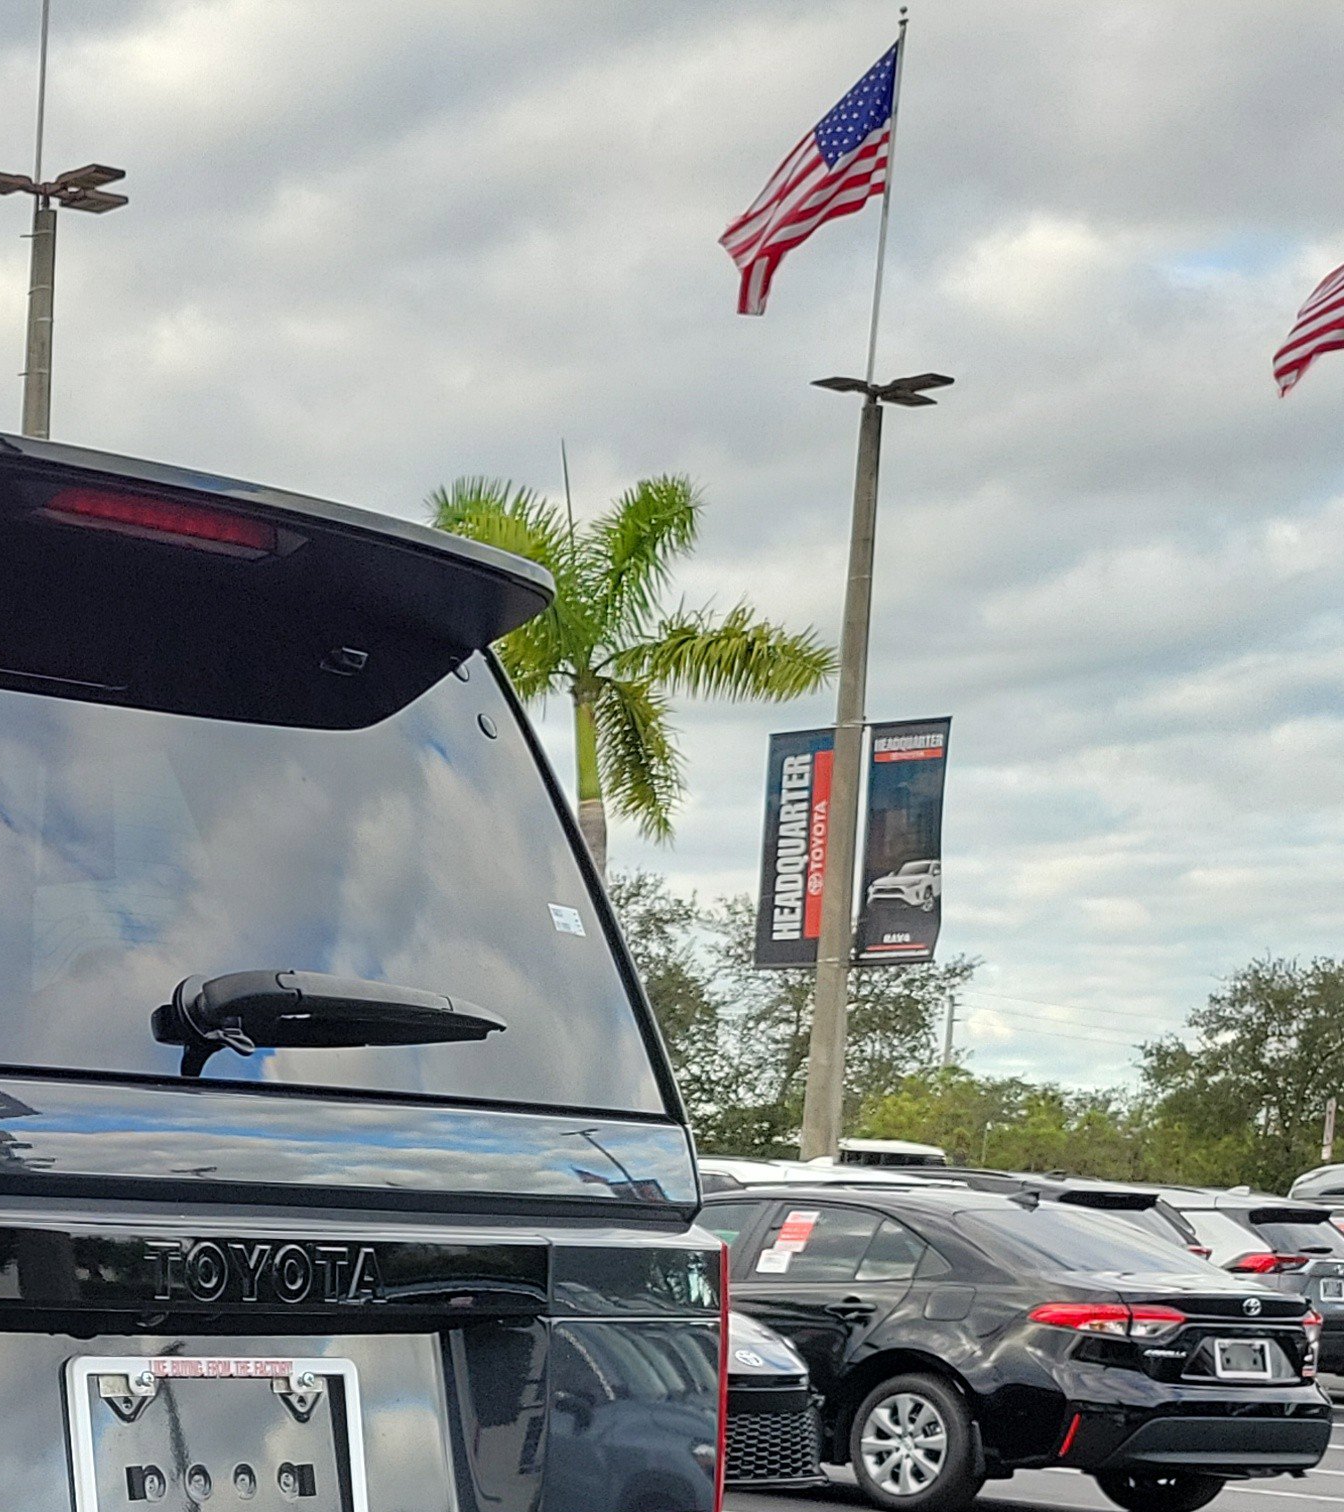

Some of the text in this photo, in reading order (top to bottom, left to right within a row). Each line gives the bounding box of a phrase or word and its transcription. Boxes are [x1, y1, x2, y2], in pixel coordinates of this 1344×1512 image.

[772, 753, 812, 941] HEADQUARTER
[810, 800, 828, 872] TOYOTA
[143, 1240, 388, 1304] TOYOTA
